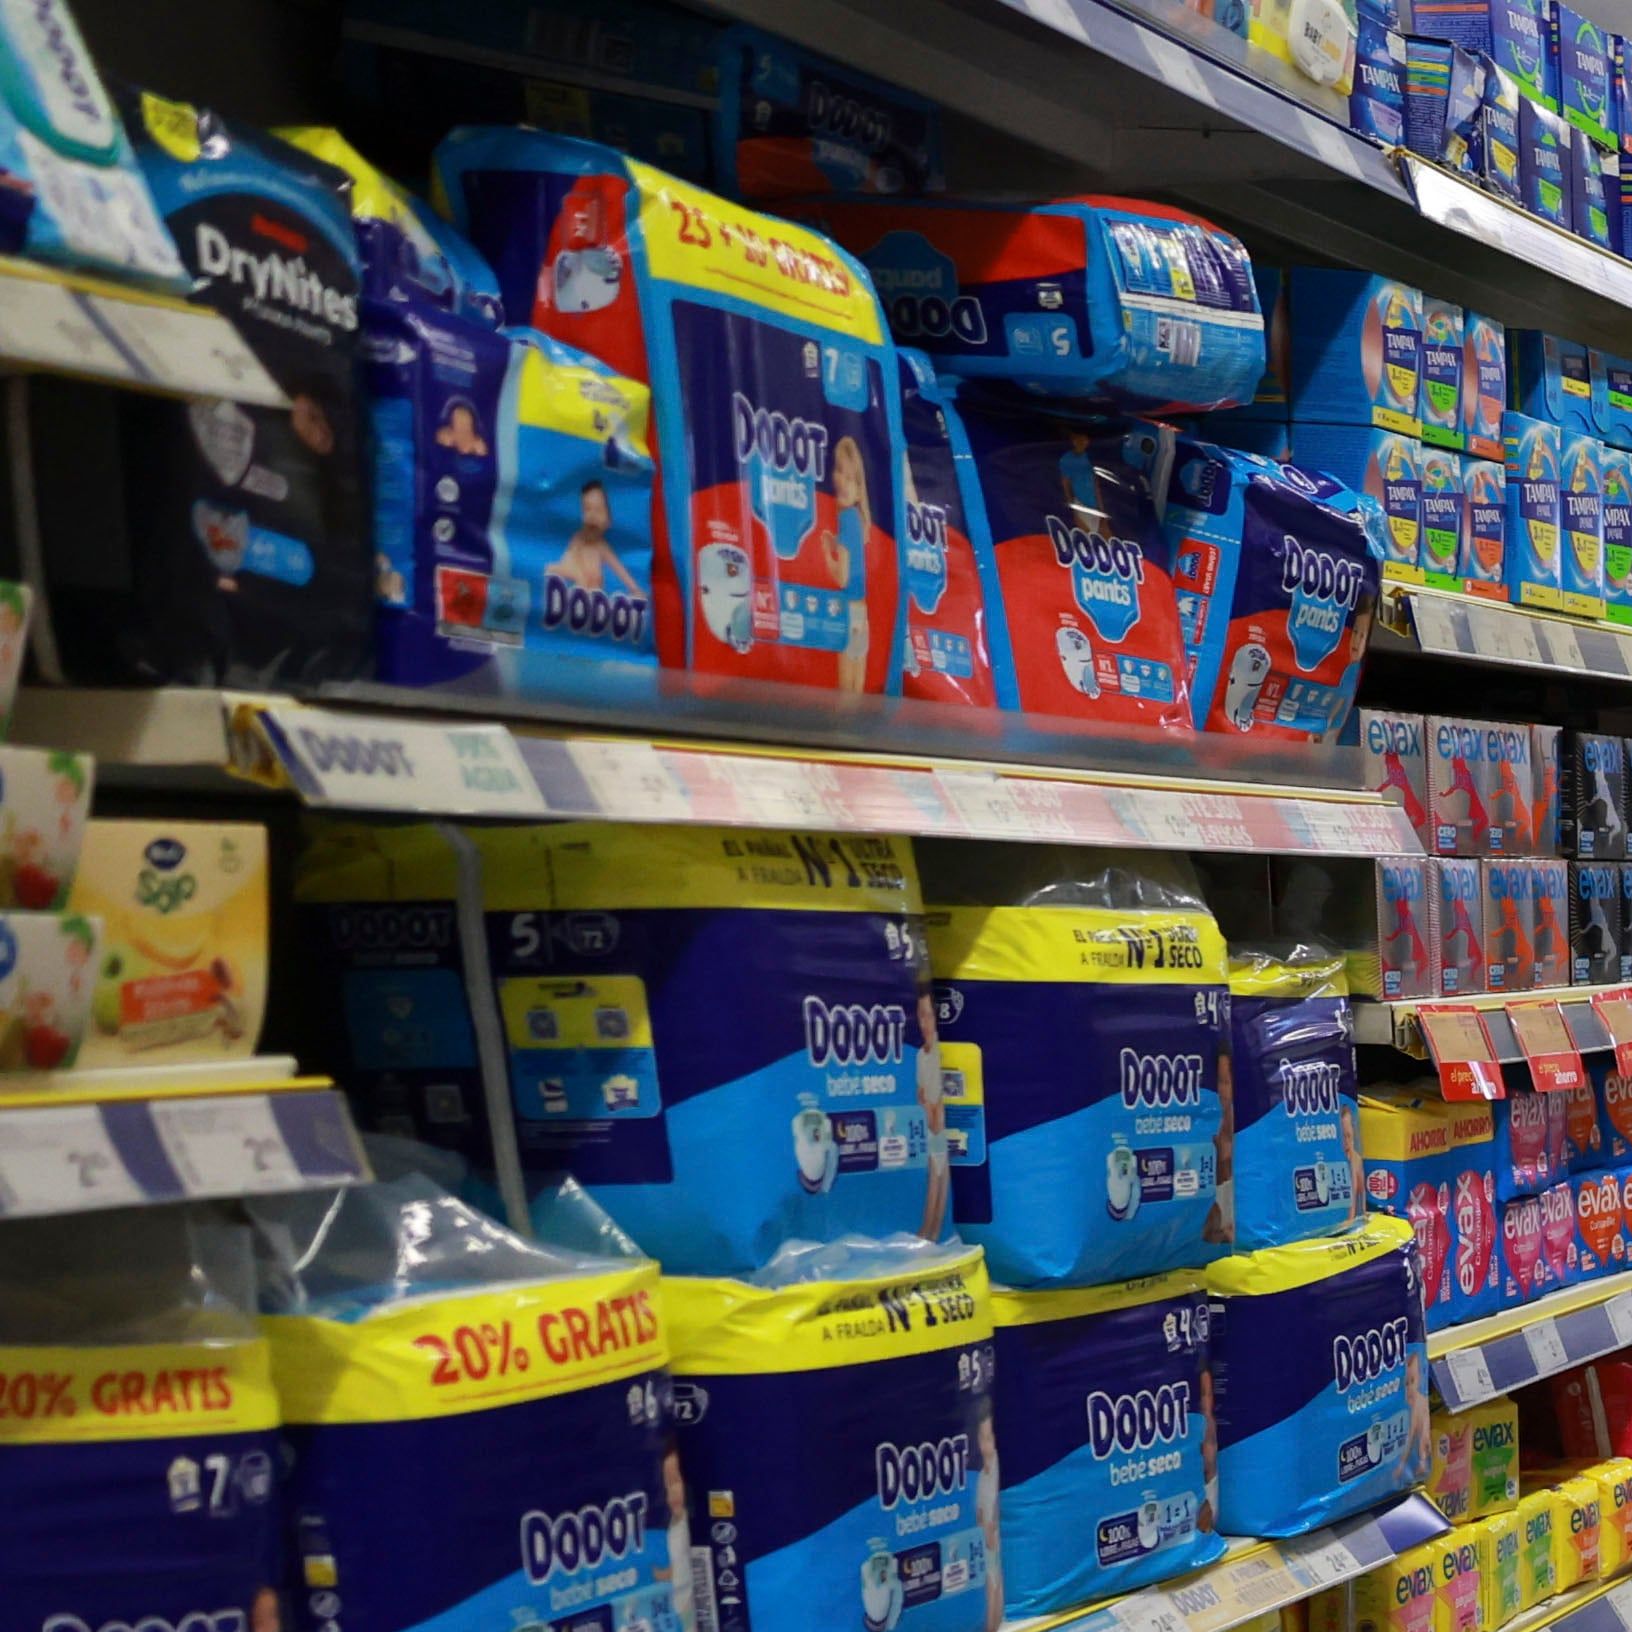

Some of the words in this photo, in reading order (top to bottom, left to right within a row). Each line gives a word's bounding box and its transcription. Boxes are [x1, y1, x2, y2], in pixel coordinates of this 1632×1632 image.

[1507, 10, 1539, 39] TAMPAX
[1361, 64, 1401, 92] TAMPAX
[1576, 50, 1604, 79] TAMPAX
[1535, 148, 1561, 175] TAMPAX
[197, 225, 358, 331] DryNites
[1386, 332, 1416, 352] TAMPAX
[1426, 350, 1457, 368] TAMPAX
[732, 392, 828, 481] DODOT
[1388, 485, 1417, 502] TAMPAX
[1424, 497, 1456, 514] TAMPAX
[1524, 483, 1556, 504] TAMPAX
[1566, 496, 1599, 516] TAMPAX
[1047, 515, 1145, 584] DODOT
[1082, 573, 1132, 607] pants
[1282, 534, 1364, 612] DODOT
[542, 574, 648, 643] DODOT
[1296, 603, 1340, 636] pants
[300, 729, 418, 777] DODOT
[1368, 718, 1421, 757] evax
[1437, 723, 1484, 761] evax
[1487, 732, 1528, 764] evax
[1584, 741, 1621, 772] evax
[1578, 868, 1616, 899] evax
[1169, 945, 1203, 969] SECO
[804, 995, 904, 1066] DODOT
[1120, 1047, 1203, 1108] DODOT
[1280, 1058, 1341, 1118] DODOT
[1555, 1070, 1579, 1085] ahorro
[1163, 1115, 1191, 1133] seco
[1453, 1113, 1492, 1139] AHORRO
[1510, 1095, 1547, 1128] evax
[1541, 1190, 1573, 1227] evax
[1577, 1181, 1621, 1219] evax
[1455, 1176, 1474, 1296] evax
[1504, 1207, 1540, 1239] evax
[941, 1296, 975, 1322] SECO
[413, 1322, 530, 1386] 20%
[538, 1290, 659, 1367] GRATIS
[1333, 1317, 1408, 1395] DODOT
[90, 1366, 234, 1417] GRATIS
[1374, 1376, 1400, 1402] seco
[1086, 1381, 1190, 1461] DODOT
[1473, 1422, 1514, 1451] evax
[877, 1434, 969, 1510] DODOT
[1110, 1460, 1147, 1487] bebé
[1148, 1451, 1182, 1480] seco
[928, 1503, 960, 1527] seco
[1526, 1508, 1552, 1543] evax
[1571, 1500, 1601, 1535] evax
[521, 1492, 647, 1585] DODOT
[1443, 1545, 1480, 1580] evax
[1396, 1564, 1436, 1604] evax
